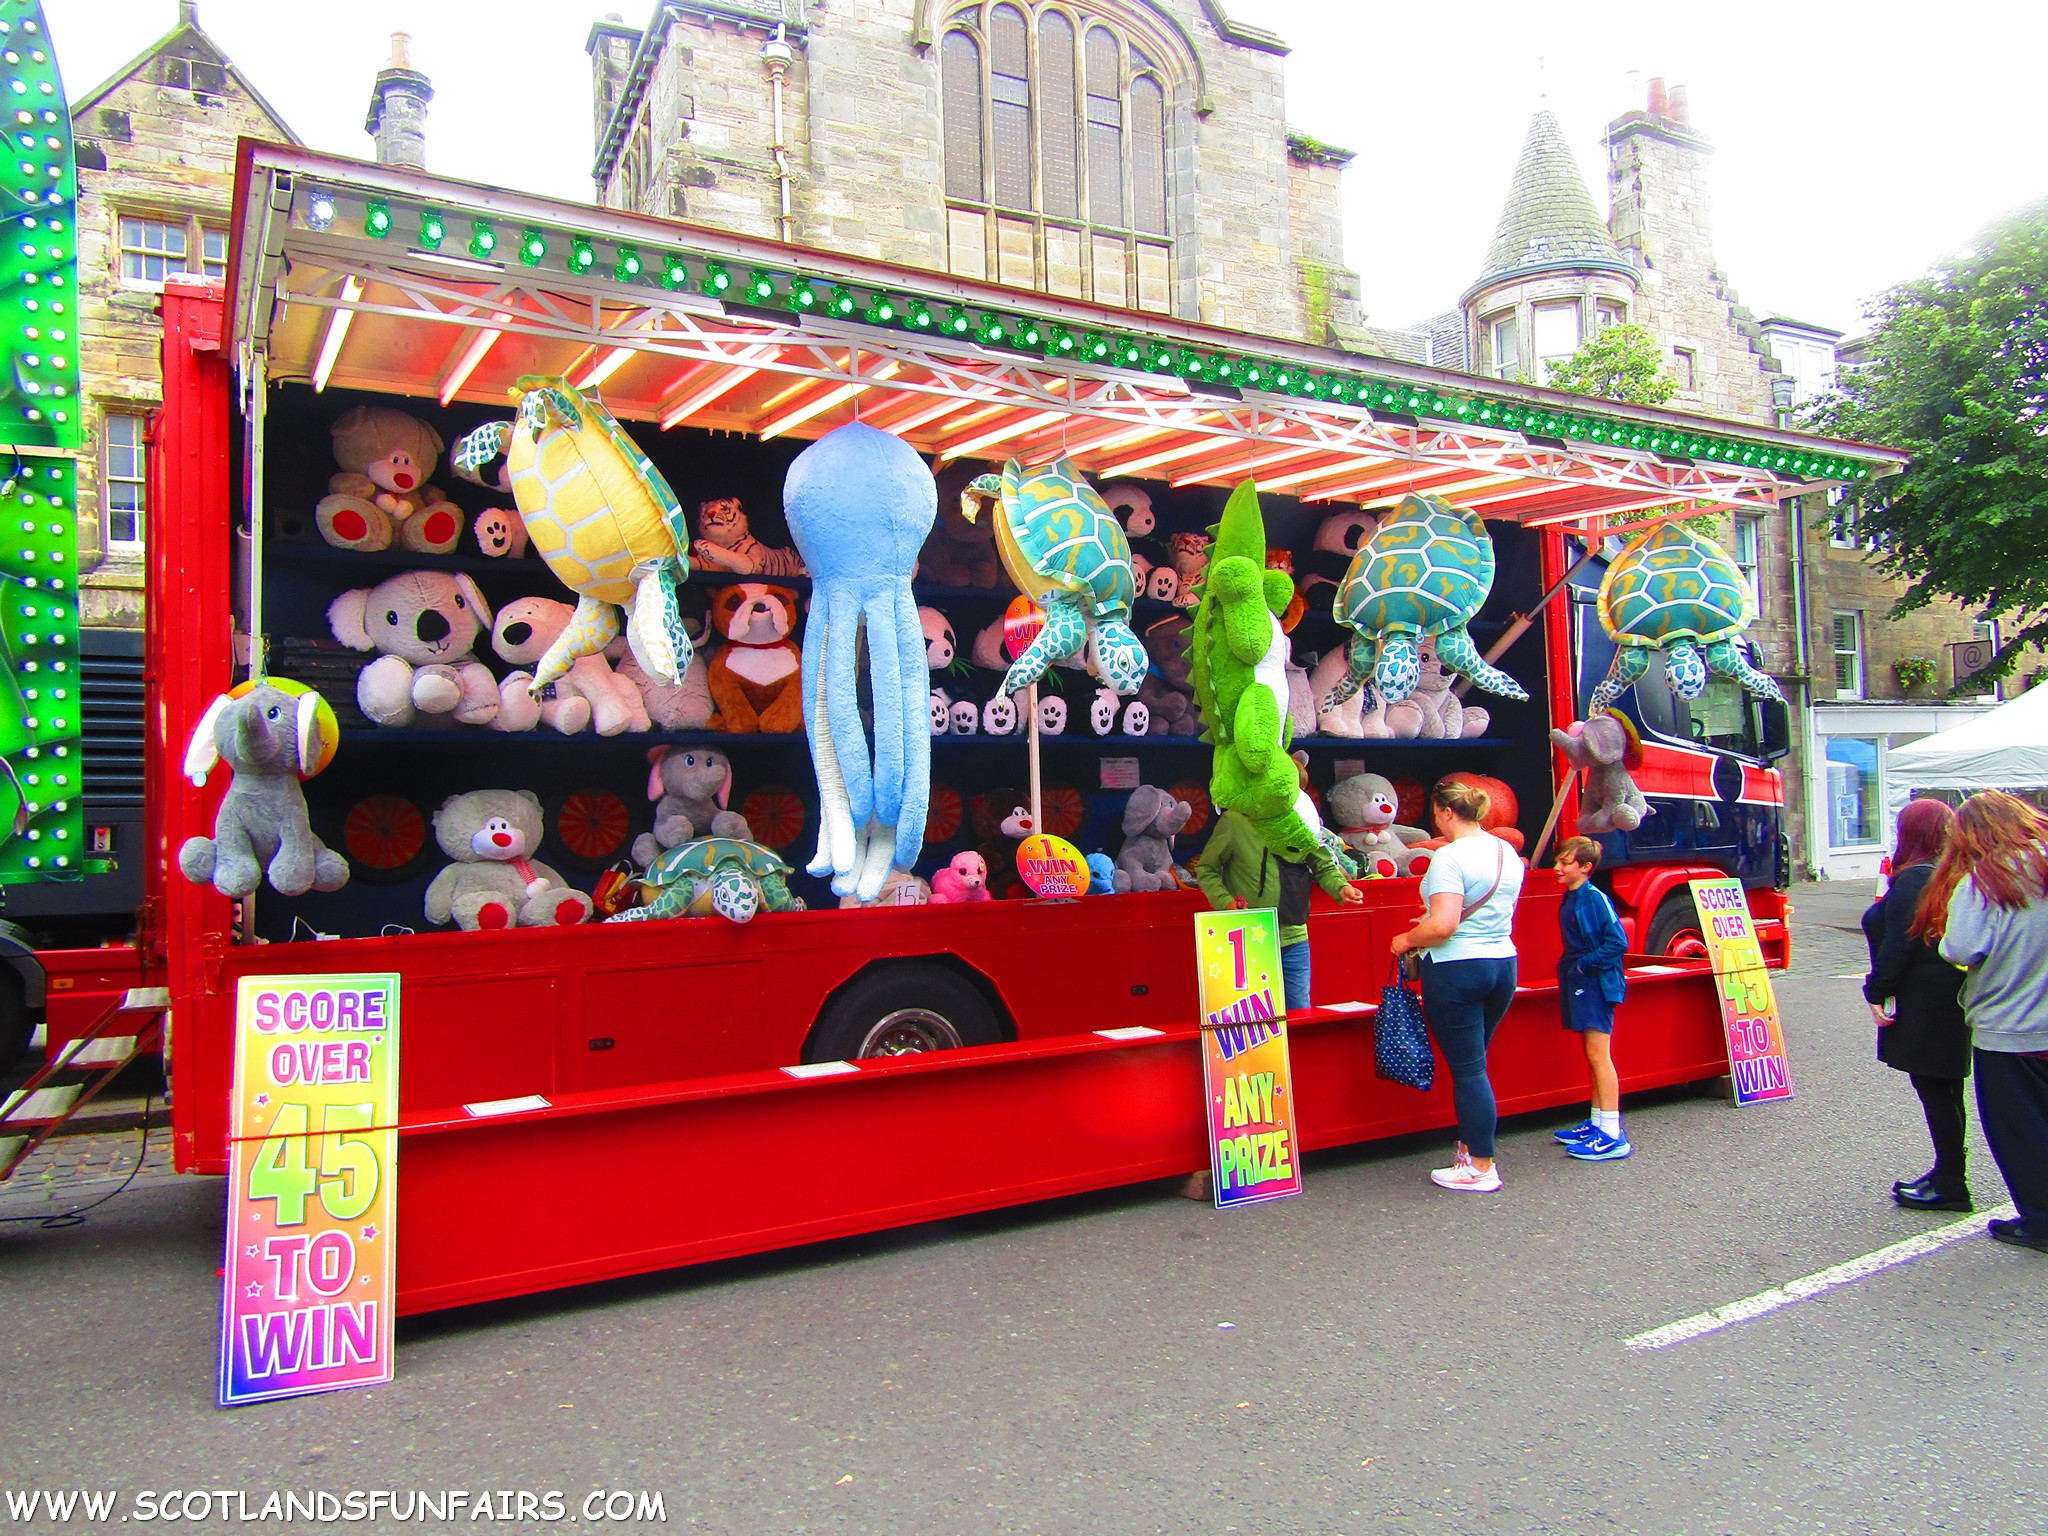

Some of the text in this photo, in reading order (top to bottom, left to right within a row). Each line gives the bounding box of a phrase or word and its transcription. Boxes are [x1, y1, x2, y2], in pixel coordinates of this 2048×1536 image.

[1027, 859, 1078, 874] WIN
[1040, 839, 1053, 858] 1
[1040, 884, 1078, 894] PRIZE
[1045, 875, 1068, 885] ANY
[1698, 888, 1743, 911] SCORE
[1712, 915, 1747, 939] OVER
[1228, 927, 1248, 990] 1
[1723, 949, 1769, 1014] 45
[255, 991, 387, 1033] SCORE
[1209, 988, 1282, 1061] WIN
[1736, 1017, 1770, 1054] TO
[271, 1042, 373, 1086] OVER
[1735, 1055, 1786, 1095] WIN
[1223, 1072, 1275, 1129] ANY
[248, 1102, 380, 1227] 45
[1219, 1130, 1293, 1190] PRIZE
[265, 1230, 356, 1301] TO
[241, 1301, 377, 1379] WIN
